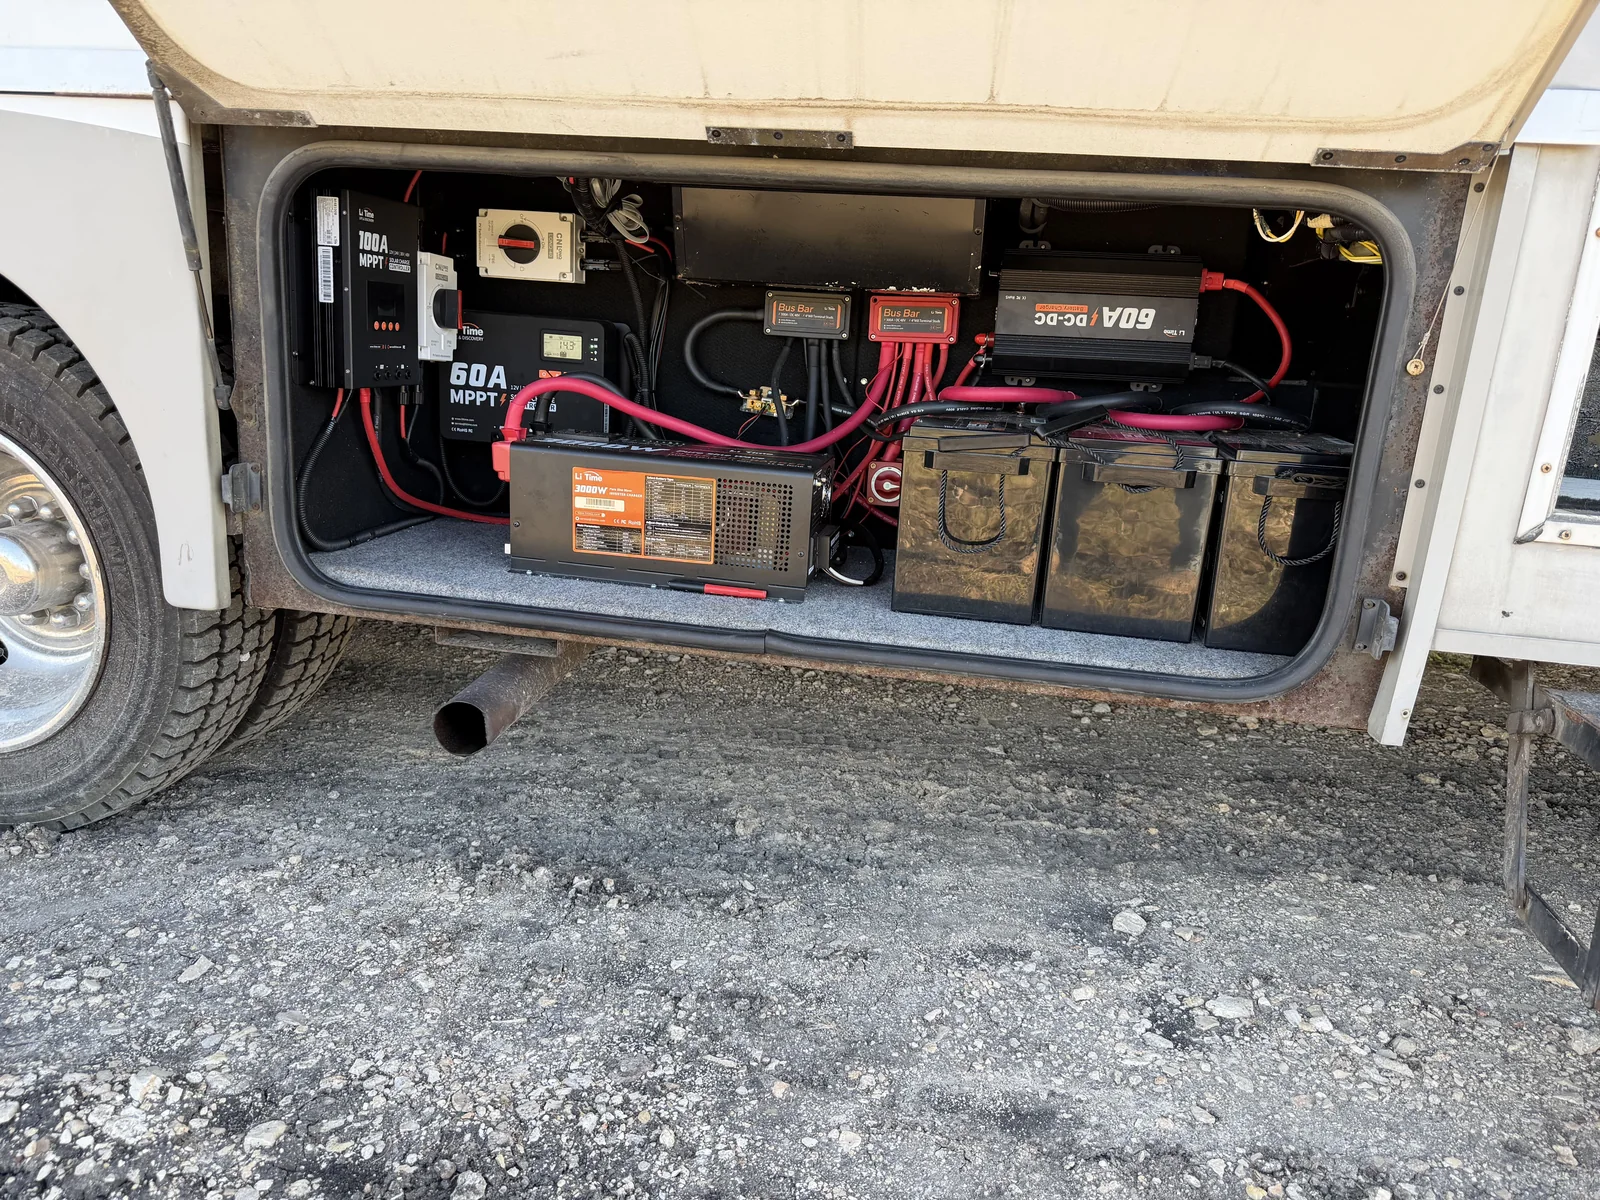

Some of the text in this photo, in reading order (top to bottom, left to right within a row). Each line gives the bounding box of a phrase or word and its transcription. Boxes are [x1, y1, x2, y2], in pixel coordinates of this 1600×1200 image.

[358, 208, 375, 218] Li Time
[358, 230, 388, 254] 100A
[359, 252, 384, 270] MPPT
[778, 303, 814, 313] Bus Bar
[884, 308, 920, 318] Bus Bar
[1034, 312, 1088, 327] DC-DC
[1102, 306, 1156, 330] 60A
[462, 326, 484, 336] Time
[450, 362, 507, 390] 60A
[450, 388, 498, 407] MPPT
[584, 472, 603, 482] Time
[574, 484, 608, 494] 3000W
